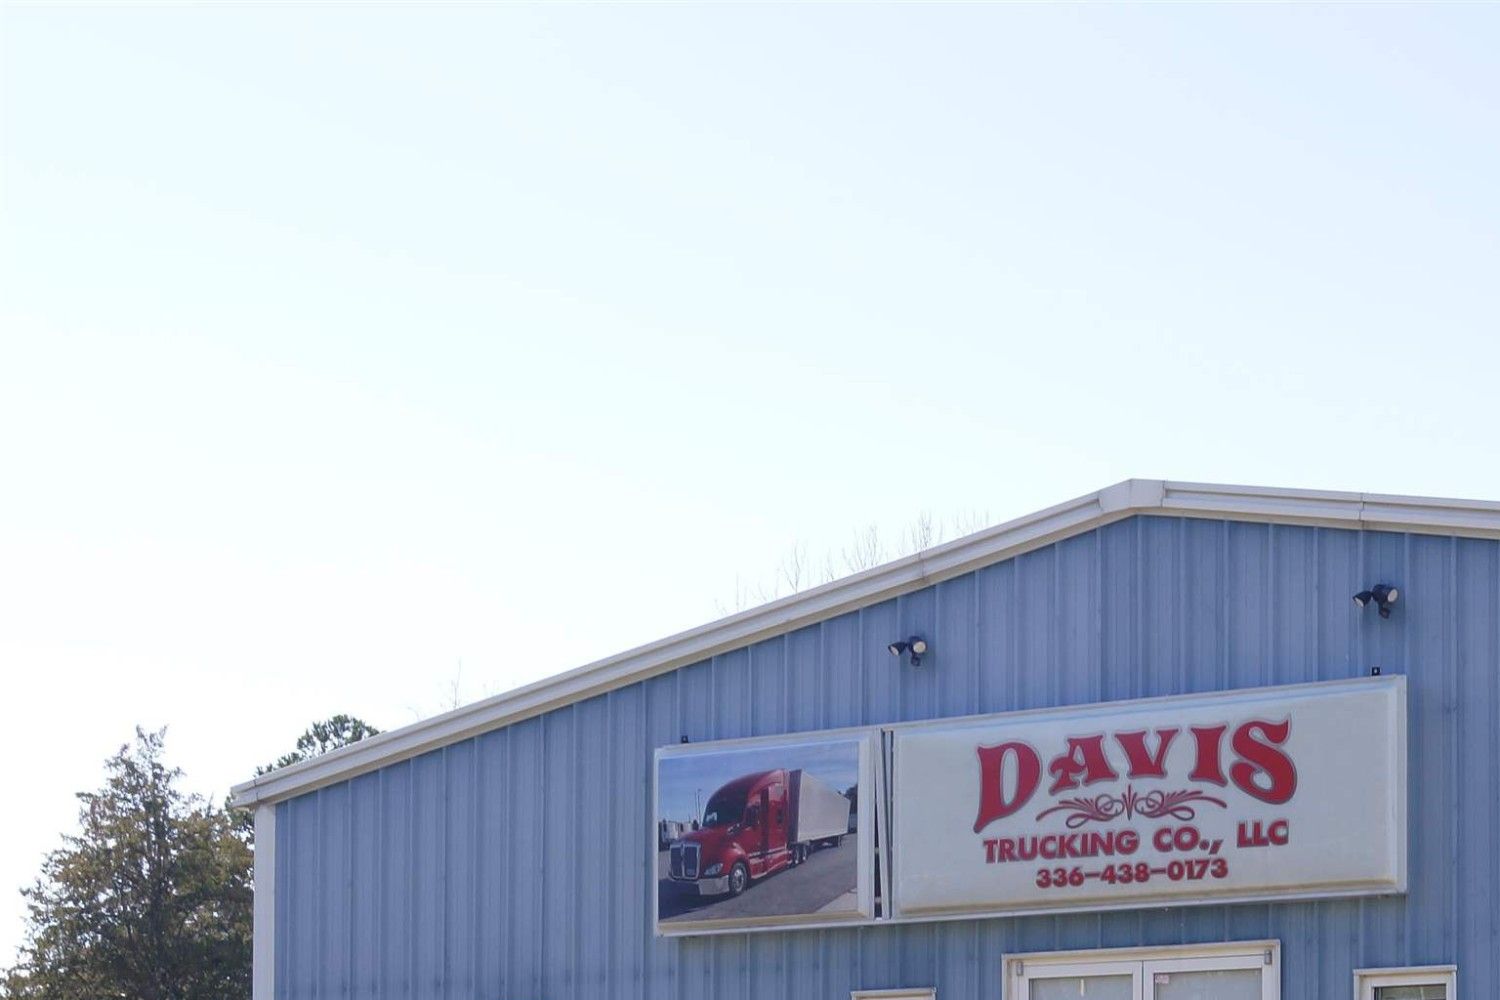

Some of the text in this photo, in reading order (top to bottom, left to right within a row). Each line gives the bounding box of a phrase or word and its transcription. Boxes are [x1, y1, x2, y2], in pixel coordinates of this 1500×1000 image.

[973, 711, 1298, 834] DAVIS
[982, 820, 1289, 864] TRUCKING CO., LLC
[1035, 858, 1228, 889] 336-438-0173
